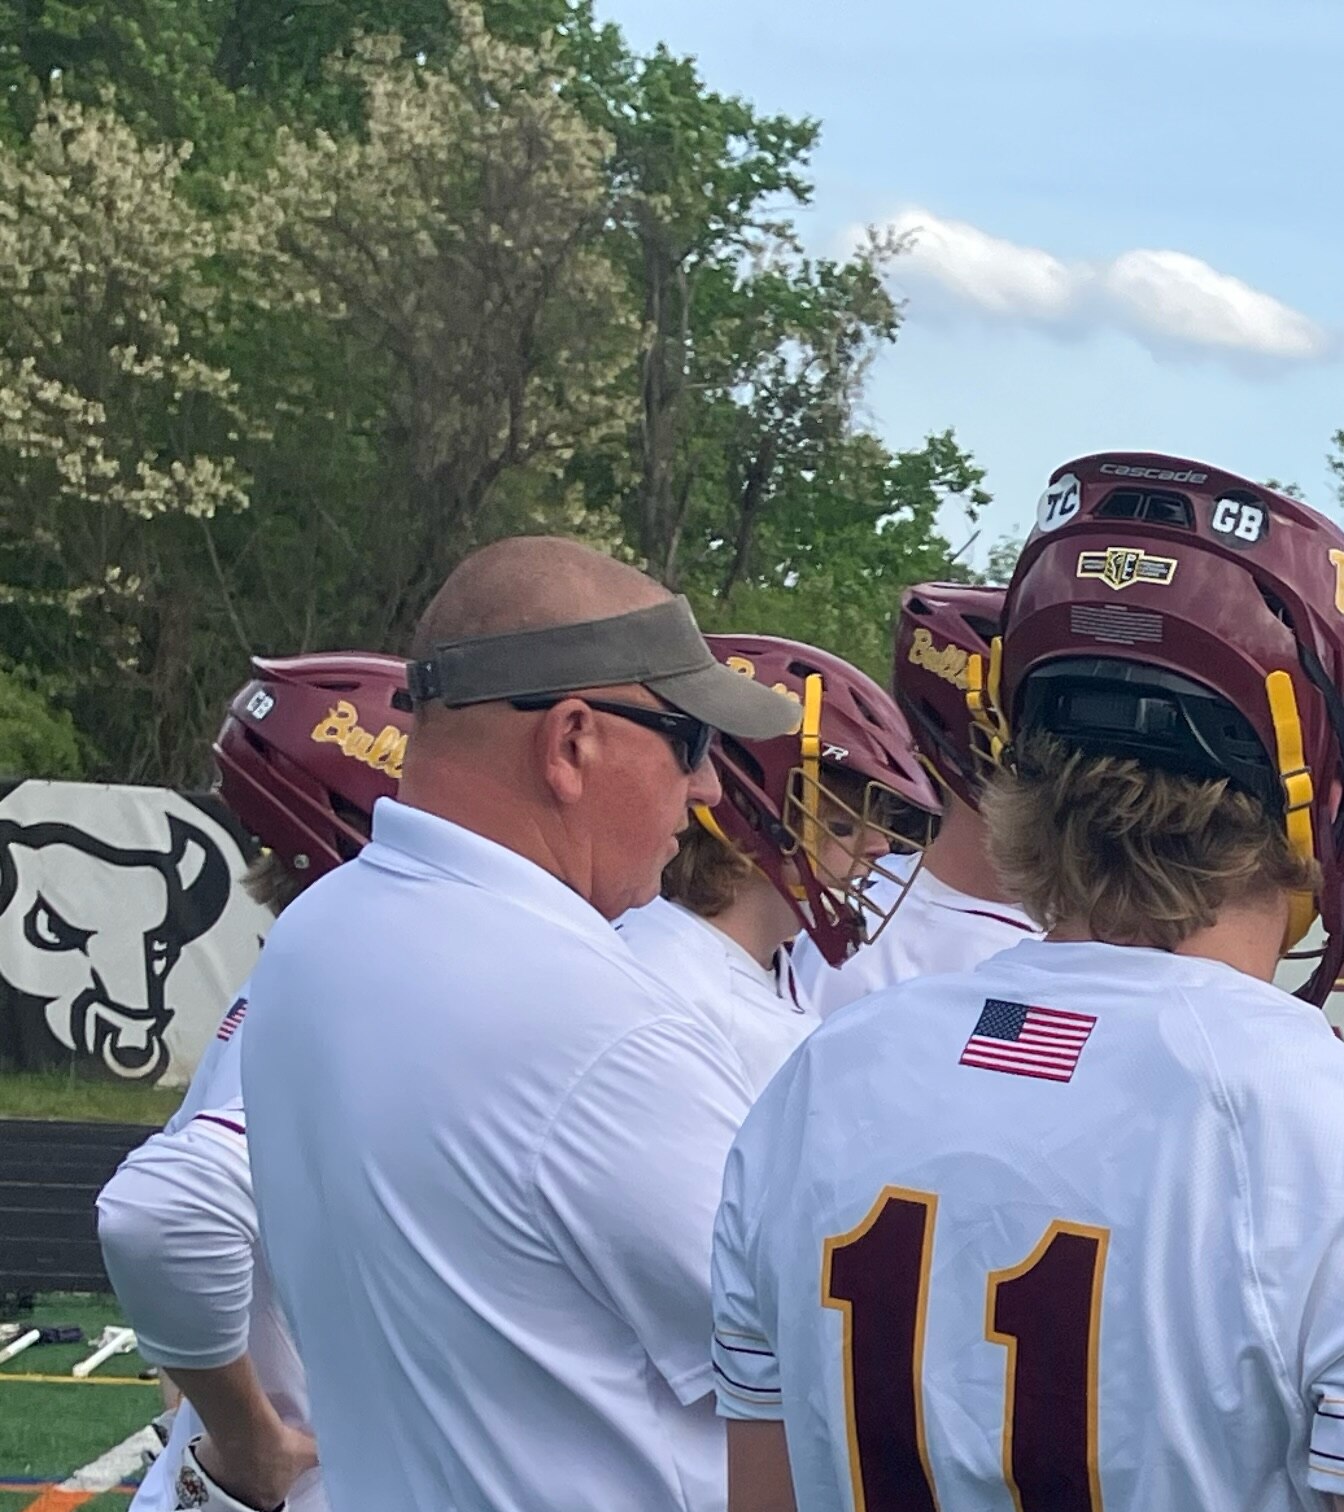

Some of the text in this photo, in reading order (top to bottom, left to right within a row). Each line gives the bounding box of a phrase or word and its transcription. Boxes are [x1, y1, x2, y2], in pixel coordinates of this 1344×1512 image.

[1046, 482, 1079, 522] TC
[1211, 498, 1265, 544] GB
[311, 700, 409, 778] Bull
